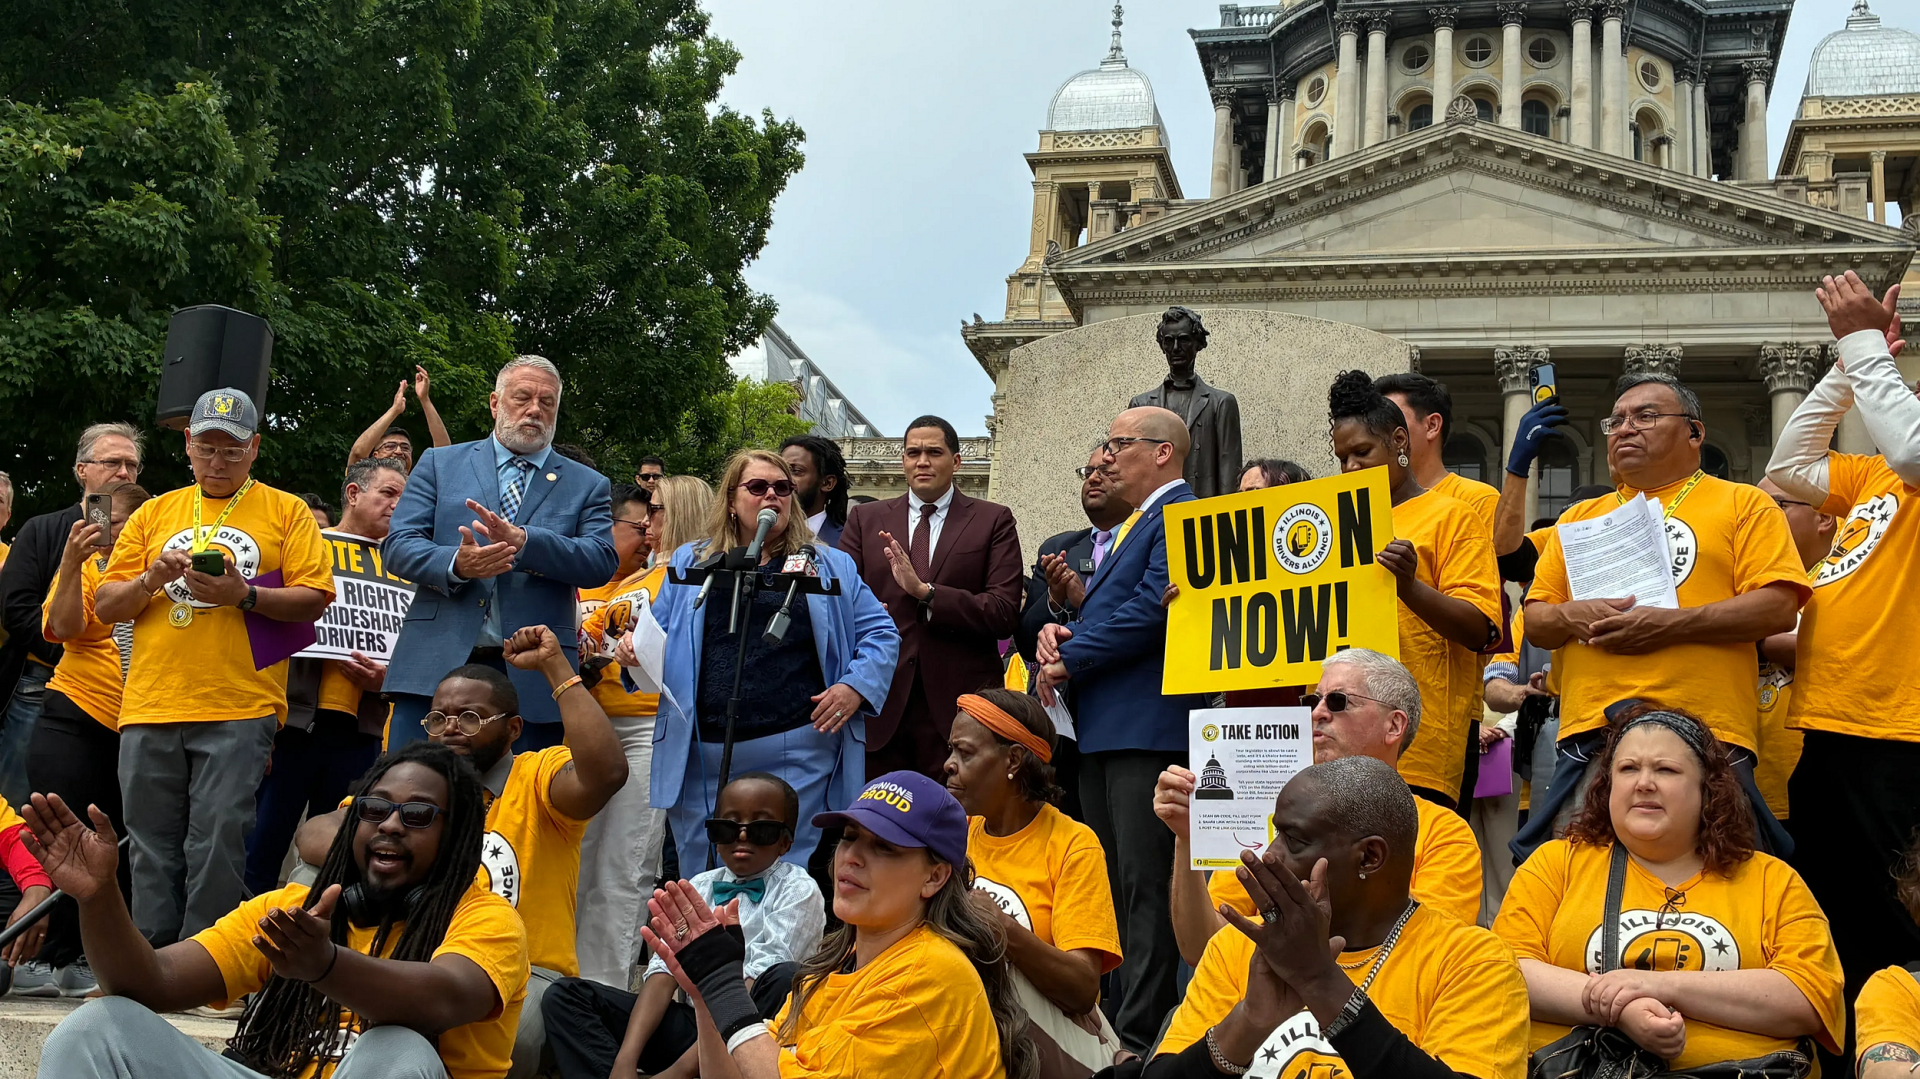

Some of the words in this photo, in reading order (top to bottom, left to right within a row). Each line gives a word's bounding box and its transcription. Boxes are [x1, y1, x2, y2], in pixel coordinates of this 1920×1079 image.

[1282, 508, 1320, 525] ILLINOIS
[321, 539, 364, 574] OTE
[1276, 538, 1300, 570] DRIVERS
[1302, 530, 1329, 570] ALLIANCE
[343, 580, 411, 615] RIGHTS
[322, 605, 405, 635] RIDESHAR
[1209, 581, 1350, 671] NOW!
[315, 626, 388, 654] DRIVERS
[1221, 724, 1252, 740] TAKE
[1255, 724, 1300, 740] ACTION
[857, 789, 911, 813] PROUD
